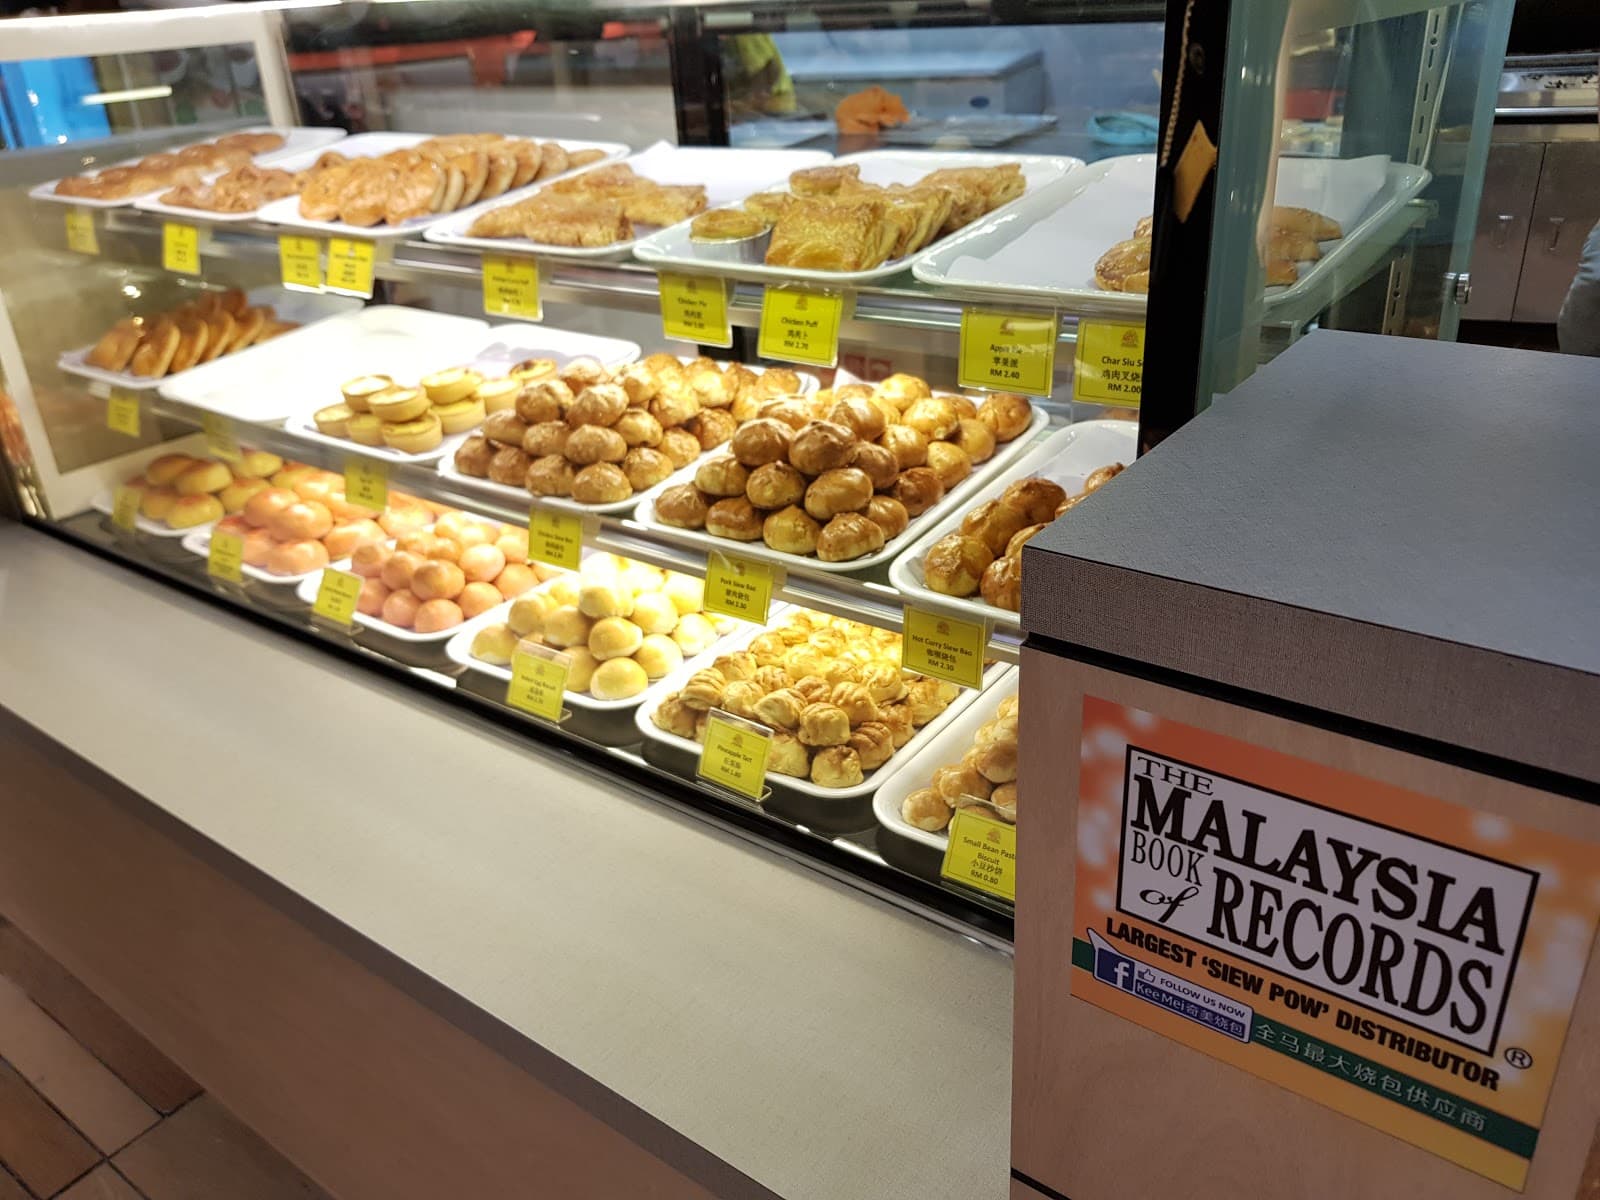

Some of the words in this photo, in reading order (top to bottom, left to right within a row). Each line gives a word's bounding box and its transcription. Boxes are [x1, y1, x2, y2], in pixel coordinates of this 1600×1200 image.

[780, 316, 804, 326] Chicken
[1102, 355, 1120, 365] Char
[1121, 357, 1135, 367] Siu
[990, 368, 1003, 377] RM
[1003, 370, 1020, 380] 2.40
[1107, 383, 1122, 392] RM
[1123, 384, 1141, 394] 2.00
[911, 634, 924, 643] Hot
[924, 637, 942, 650] Curry
[943, 642, 959, 653] Siew
[960, 647, 973, 657] Bao
[927, 658, 939, 667] RM
[940, 661, 955, 672] 2.30
[1138, 756, 1214, 796] THE
[962, 836, 982, 849] Small
[981, 843, 1000, 855] Bean
[1000, 849, 1016, 860] Past
[976, 852, 1001, 866] Biscuit
[1131, 830, 1205, 887] BOOK
[970, 869, 983, 880] RM
[983, 874, 999, 885] 0.80
[1130, 774, 1504, 957] MALAYSIA
[1140, 886, 1200, 923] of
[1206, 866, 1493, 1035] RECORDS
[1106, 917, 1197, 969] LARGEST
[1335, 1008, 1501, 1091] DISTRIBUTOR
[1159, 978, 1201, 1000] FOLLOW
[1202, 995, 1216, 1007] US
[1218, 1003, 1246, 1019] NOW
[1255, 1023, 1486, 1132] 全马最大烧包供应商
